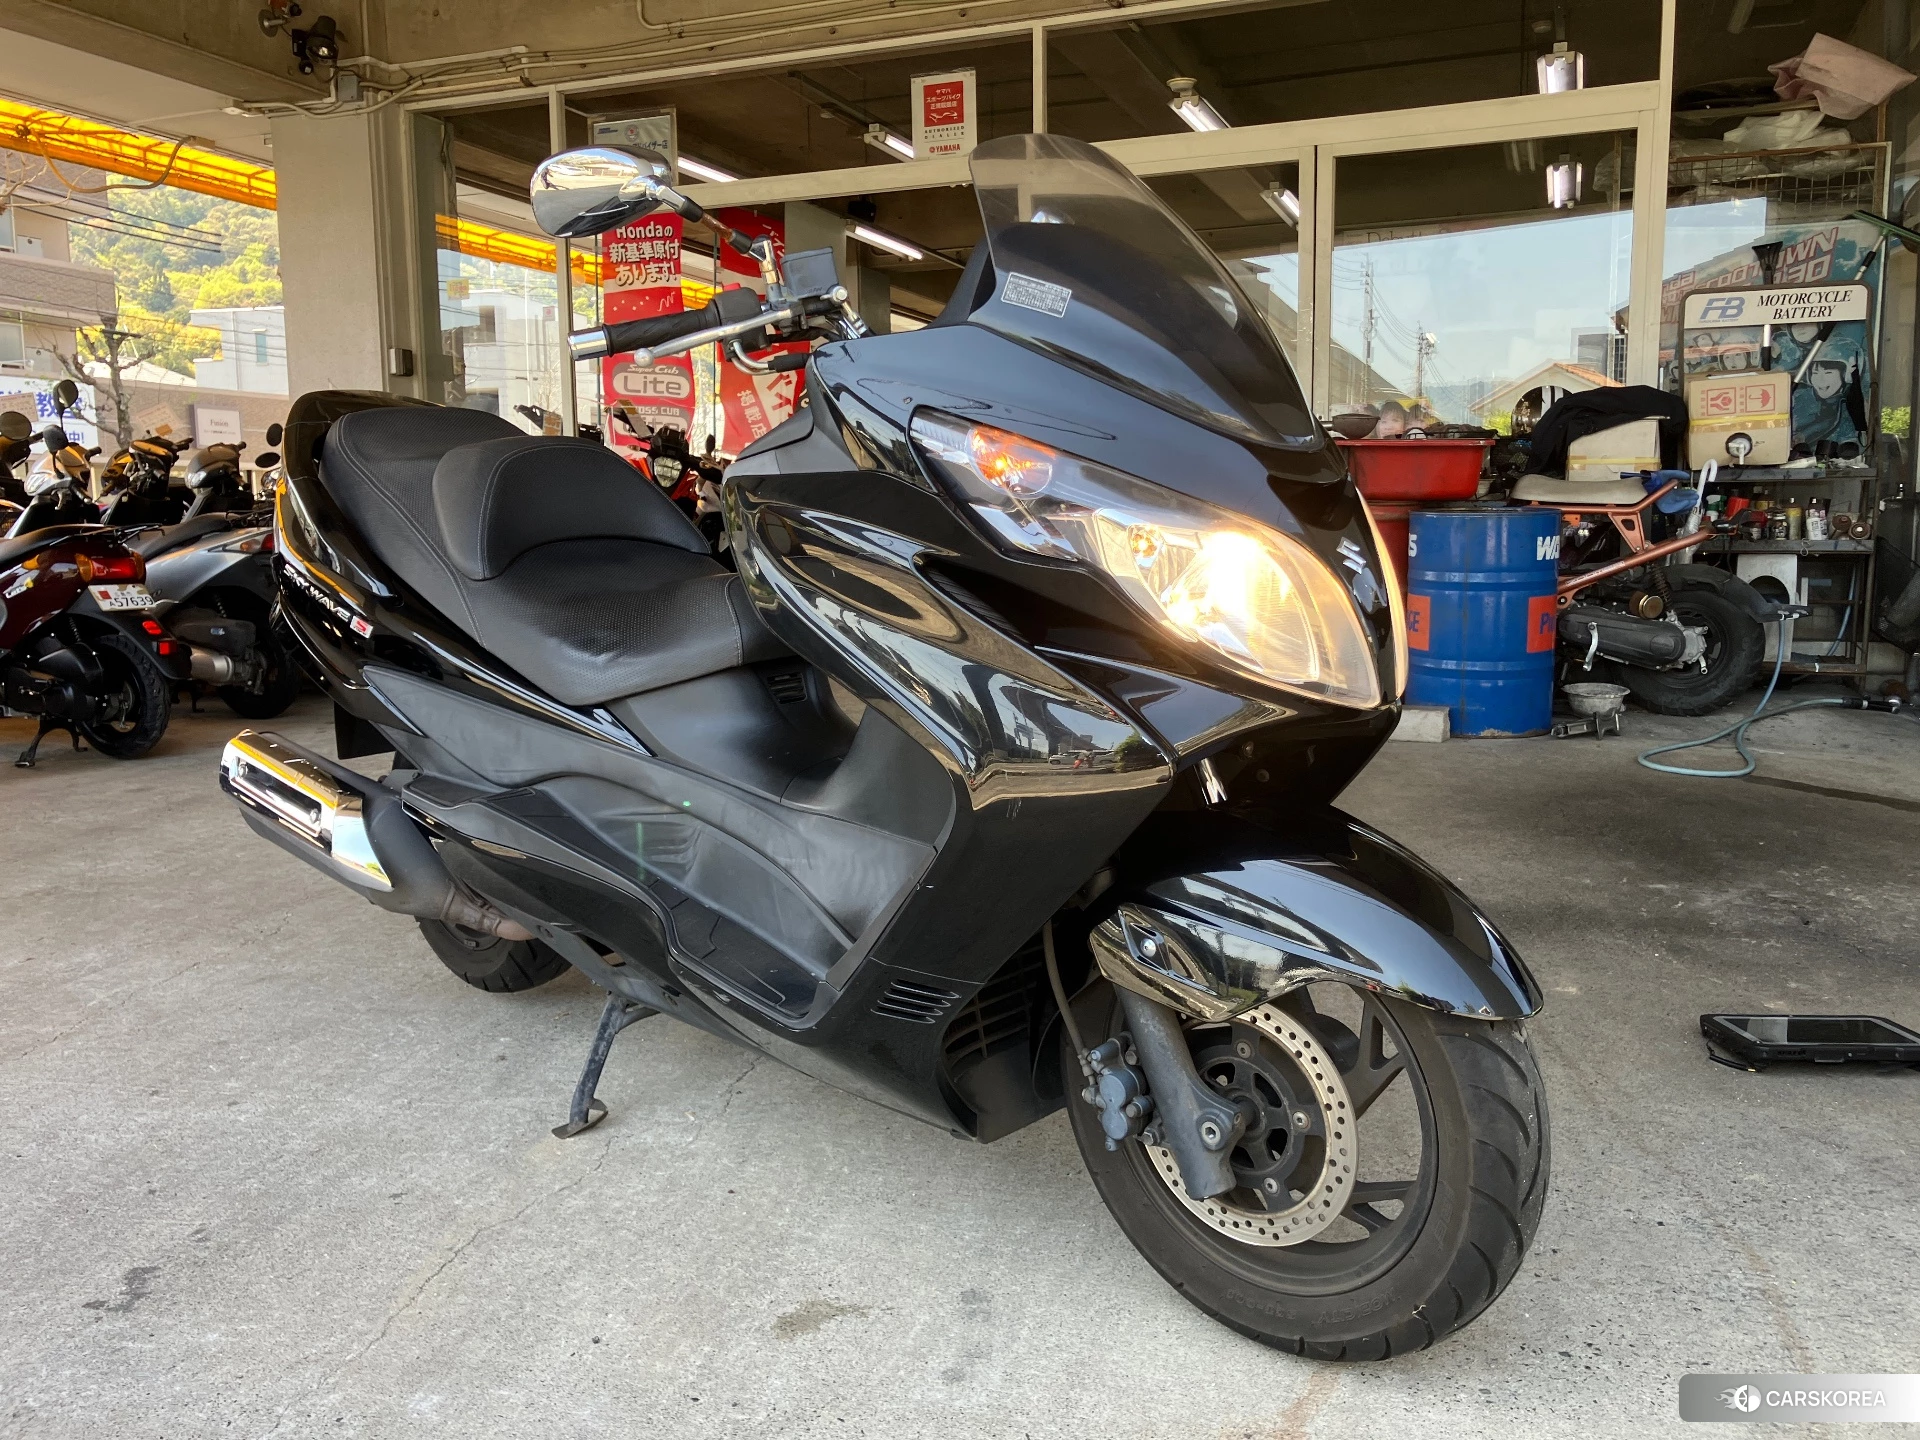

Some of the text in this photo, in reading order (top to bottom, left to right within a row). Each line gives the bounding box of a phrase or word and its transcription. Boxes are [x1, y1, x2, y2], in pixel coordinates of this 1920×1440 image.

[935, 144, 960, 152] YAMAHA
[608, 239, 680, 263] 新基準原付
[1699, 296, 1746, 320] FB
[1756, 290, 1852, 307] MOTORCYCLE
[1772, 305, 1836, 320] BATTERY
[654, 365, 679, 374] Cub
[623, 375, 682, 396] Lite
[660, 407, 680, 416] CUB
[1536, 534, 1560, 560] WA
